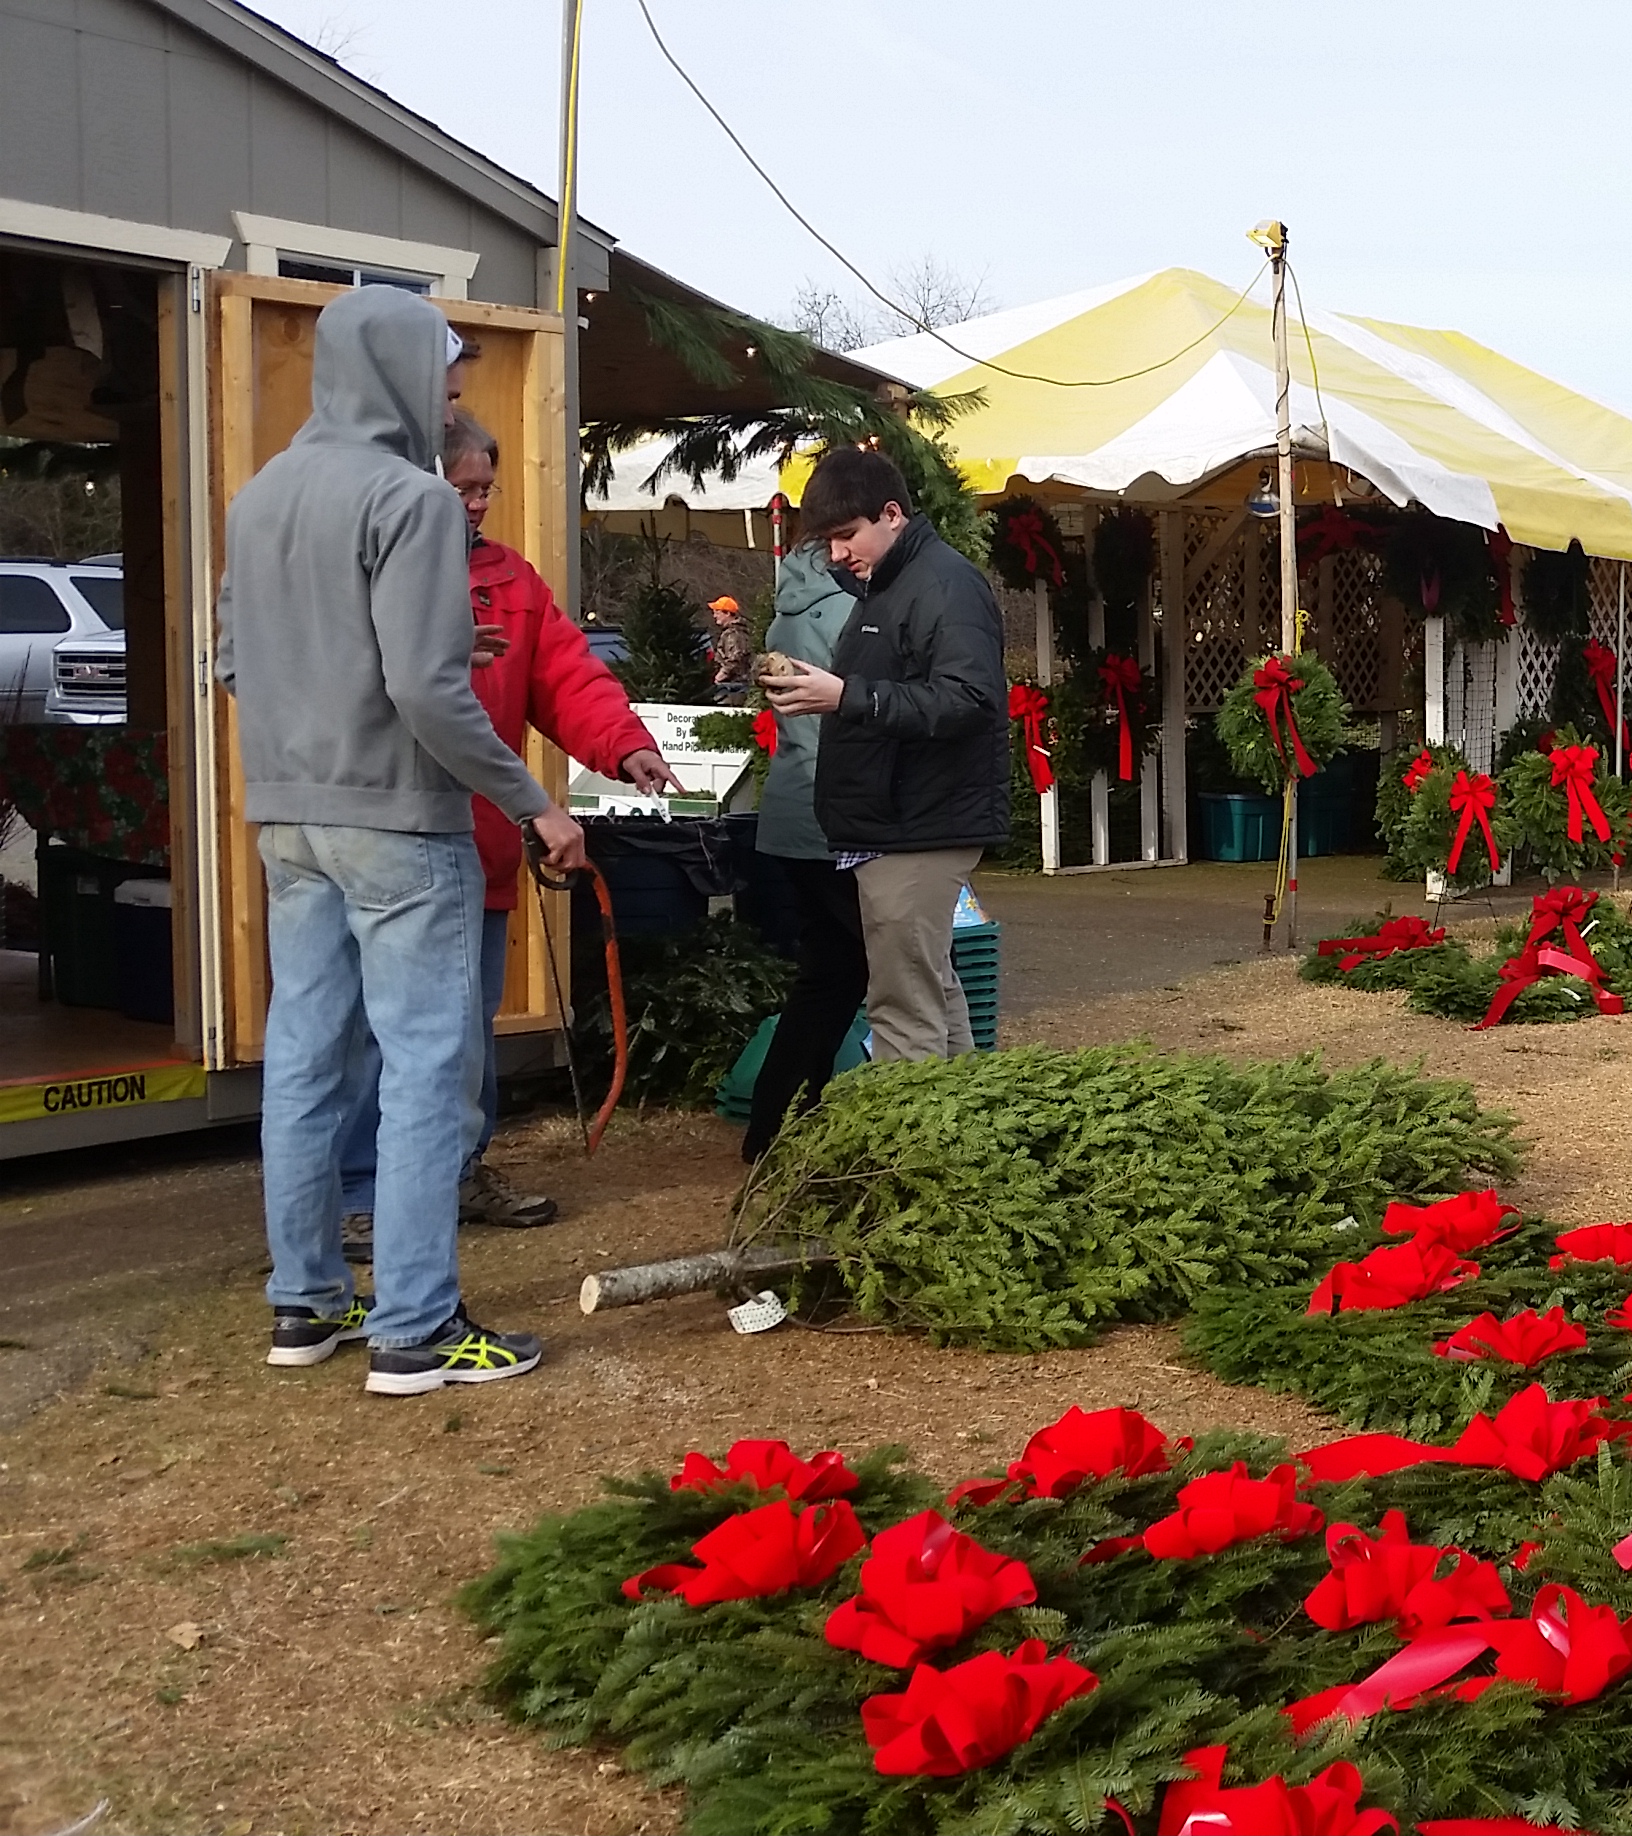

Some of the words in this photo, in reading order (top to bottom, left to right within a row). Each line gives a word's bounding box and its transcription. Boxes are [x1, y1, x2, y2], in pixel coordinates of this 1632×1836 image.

[667, 713, 698, 723] Decora
[676, 727, 687, 739] By
[662, 741, 684, 752] Hand
[44, 1075, 146, 1112] CAUTION
